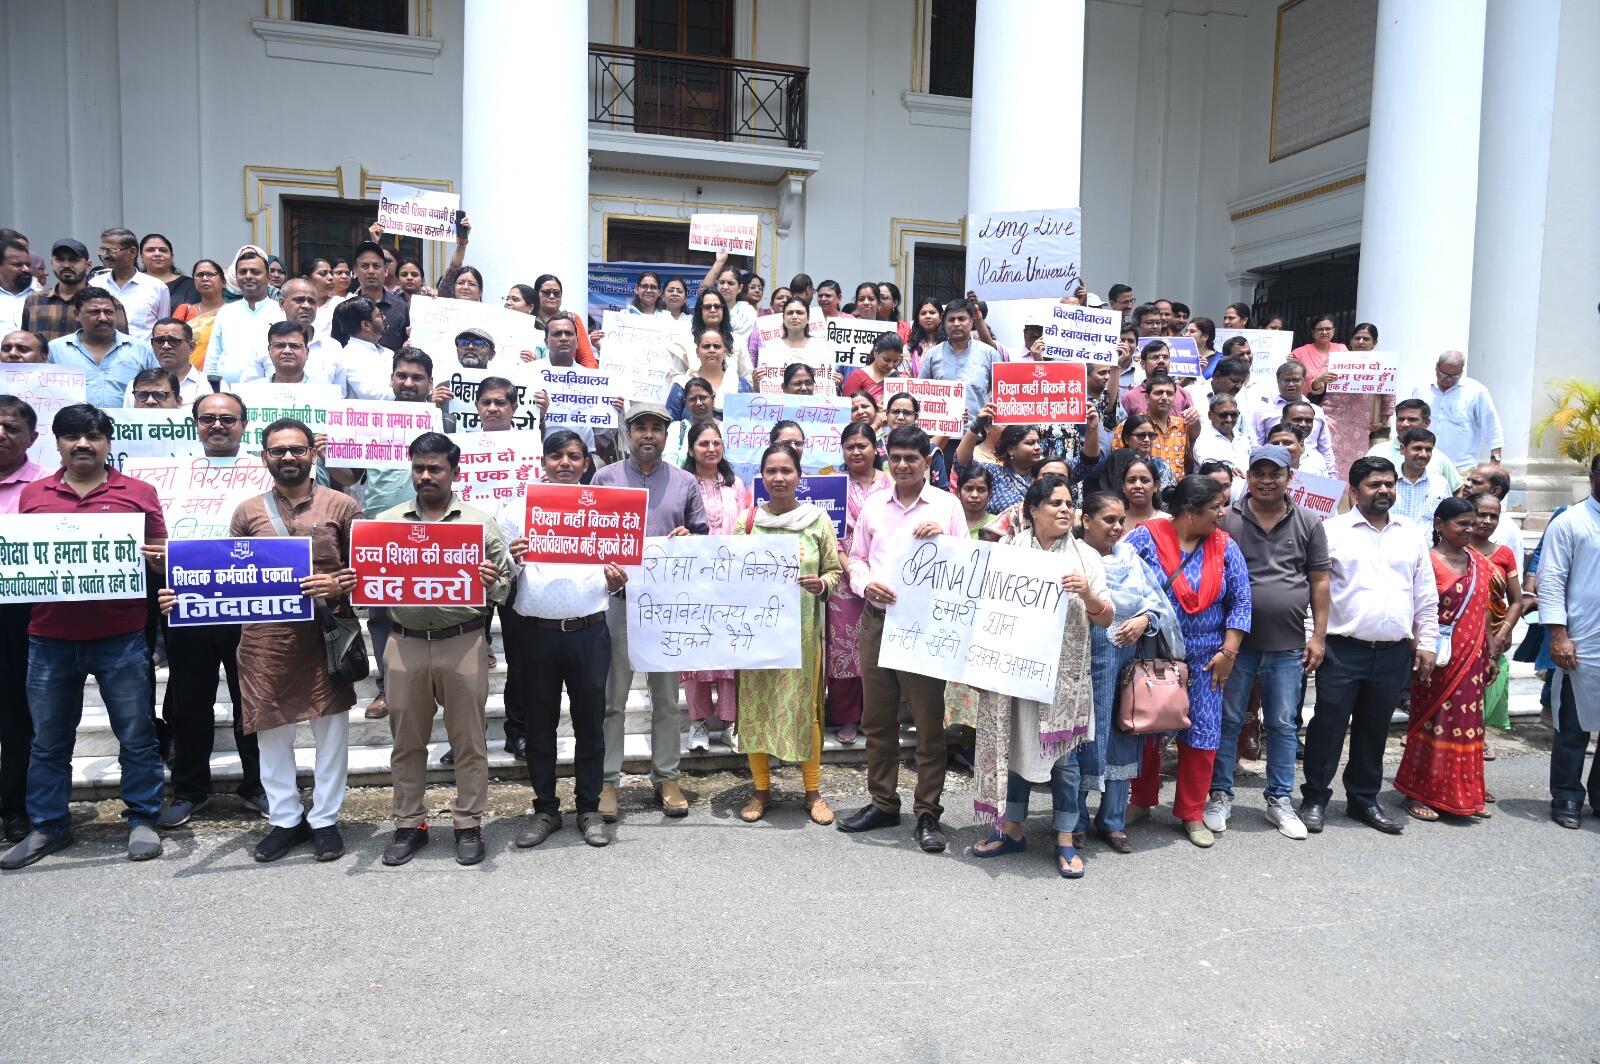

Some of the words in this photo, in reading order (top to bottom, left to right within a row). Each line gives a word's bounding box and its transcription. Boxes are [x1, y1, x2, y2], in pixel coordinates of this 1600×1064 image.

[978, 217, 1029, 255] Long
[1034, 215, 1075, 236] Live
[978, 257, 1025, 285] Patna
[1026, 256, 1080, 291] University
[1053, 306, 1112, 325] विश्वविद्यालय
[827, 321, 852, 344] बिहार
[1044, 324, 1058, 337] की
[1061, 329, 1101, 343] स्वायत्तता
[1104, 334, 1118, 344] पर
[1046, 345, 1074, 358] हमला
[1075, 347, 1090, 360] बंद
[1093, 351, 1112, 362] करो
[1369, 361, 1381, 370] दो
[451, 373, 480, 402] बिहा
[907, 380, 951, 397] विश्वविद्यालय
[953, 383, 964, 398] की
[998, 380, 1020, 395] शिक्षा
[1022, 380, 1039, 395] नहीं
[1041, 380, 1066, 394] बिकने
[570, 410, 587, 423] बंद
[590, 413, 611, 424] करो
[996, 397, 1035, 416] विश्वविद्यालय
[1036, 397, 1048, 416] नहीं
[328, 411, 343, 426] उच्च
[346, 408, 369, 426] शिक्षा
[372, 413, 383, 427] का
[386, 413, 413, 429] सम्मान
[497, 448, 515, 462] दो
[475, 470, 510, 482] एक
[493, 487, 512, 498] एक
[531, 506, 561, 527] शिक्षा
[564, 509, 586, 528] नहीं
[588, 509, 620, 529] बिकने
[33, 541, 49, 564] पर
[53, 541, 87, 564] हमला
[92, 533, 110, 563] बंद
[114, 533, 140, 567] करो,
[355, 546, 383, 563] उच्च
[386, 541, 418, 565] शिक्षा
[421, 542, 440, 564] की
[443, 542, 479, 565] बर्बादी
[528, 528, 579, 554] विश्वविद्यालय
[580, 531, 596, 556] नहीं
[597, 534, 620, 560] झुकने
[172, 566, 211, 586] शिक्षक
[214, 563, 258, 585] कर्मचारी
[643, 544, 698, 584] शिक्षा
[700, 545, 736, 582] नहीं
[61, 570, 75, 595] को
[108, 568, 126, 593] रहने
[363, 566, 405, 601] बंद
[412, 568, 473, 601] करो
[177, 591, 303, 619] जिंदाबाद
[754, 595, 785, 627] नहीं
